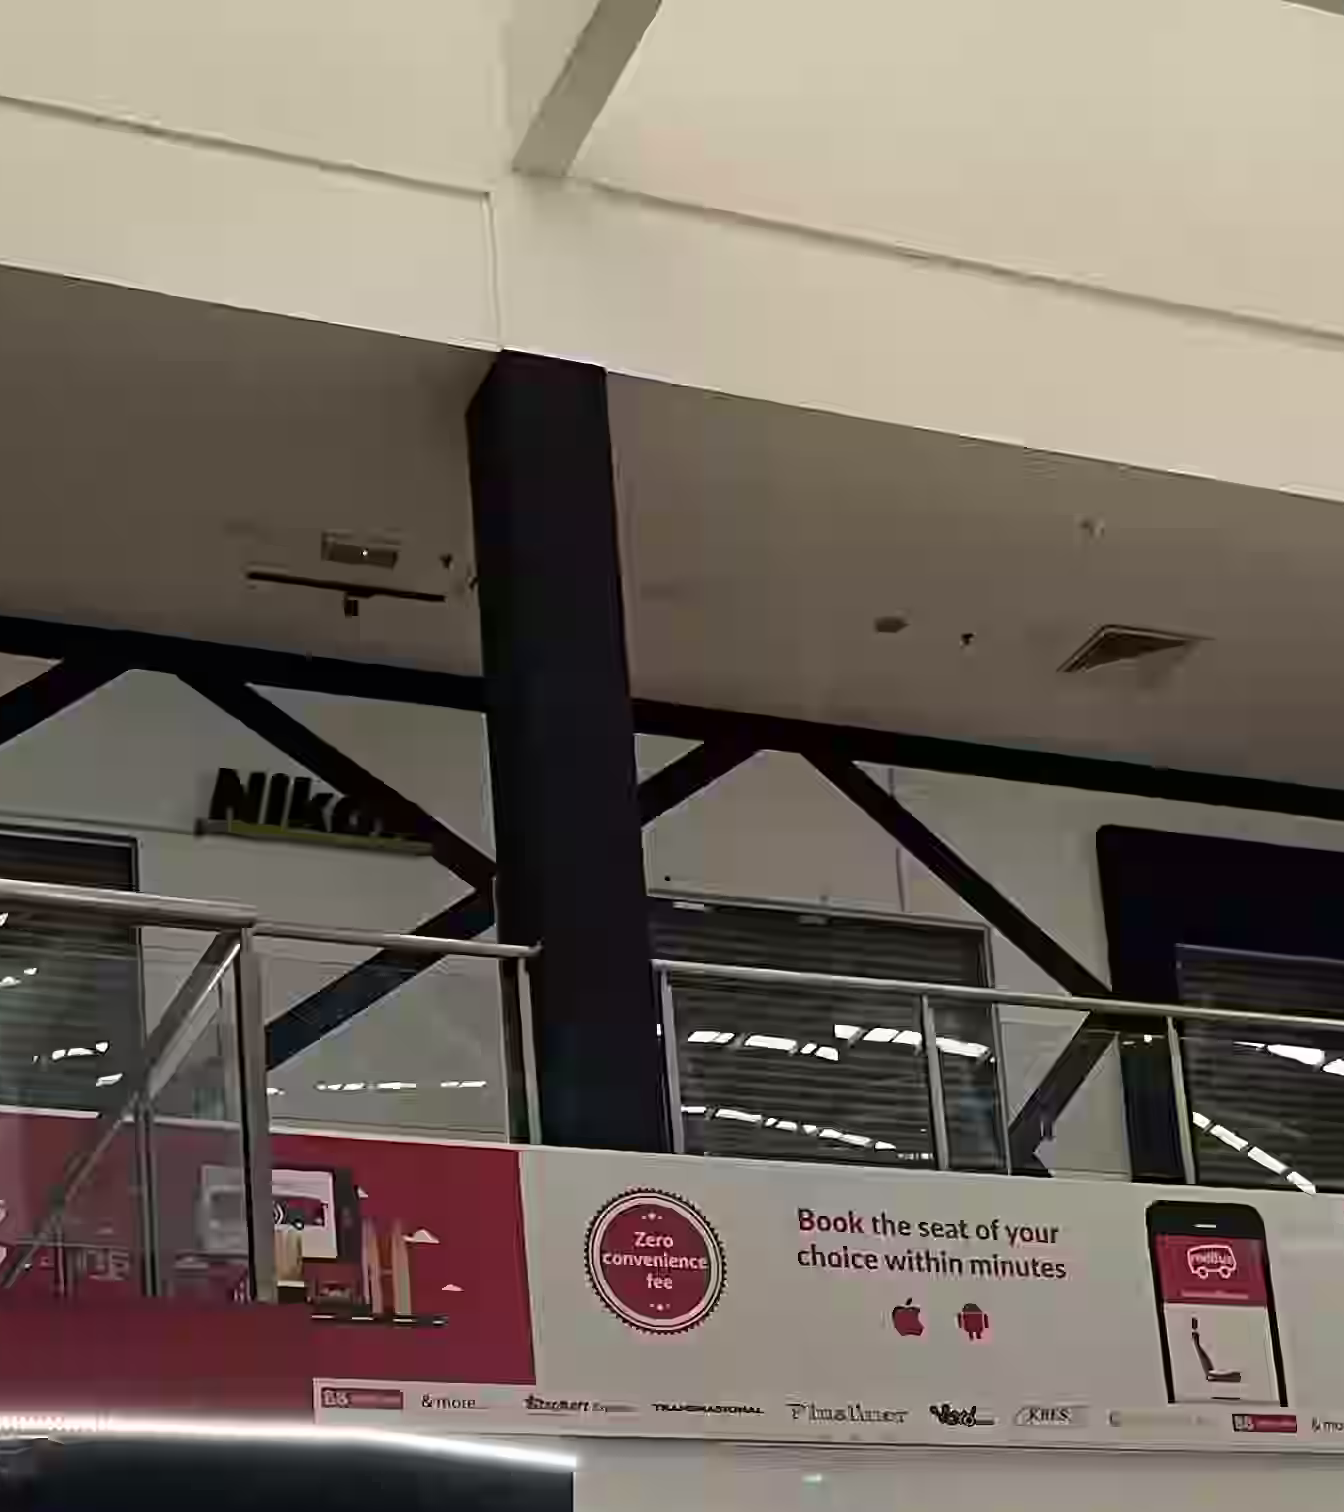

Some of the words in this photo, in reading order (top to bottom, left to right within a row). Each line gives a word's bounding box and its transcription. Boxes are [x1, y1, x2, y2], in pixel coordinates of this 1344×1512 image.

[797, 1208, 865, 1234] Book
[872, 1212, 911, 1237] the
[918, 1217, 968, 1241] seat
[974, 1219, 1001, 1242] of
[1006, 1223, 1059, 1246] your
[634, 1231, 674, 1248] Zero
[602, 1252, 709, 1270] convenience
[797, 1245, 879, 1273] choice
[885, 1251, 963, 1278] within
[970, 1255, 1067, 1281] minutes
[646, 1272, 673, 1290] fee
